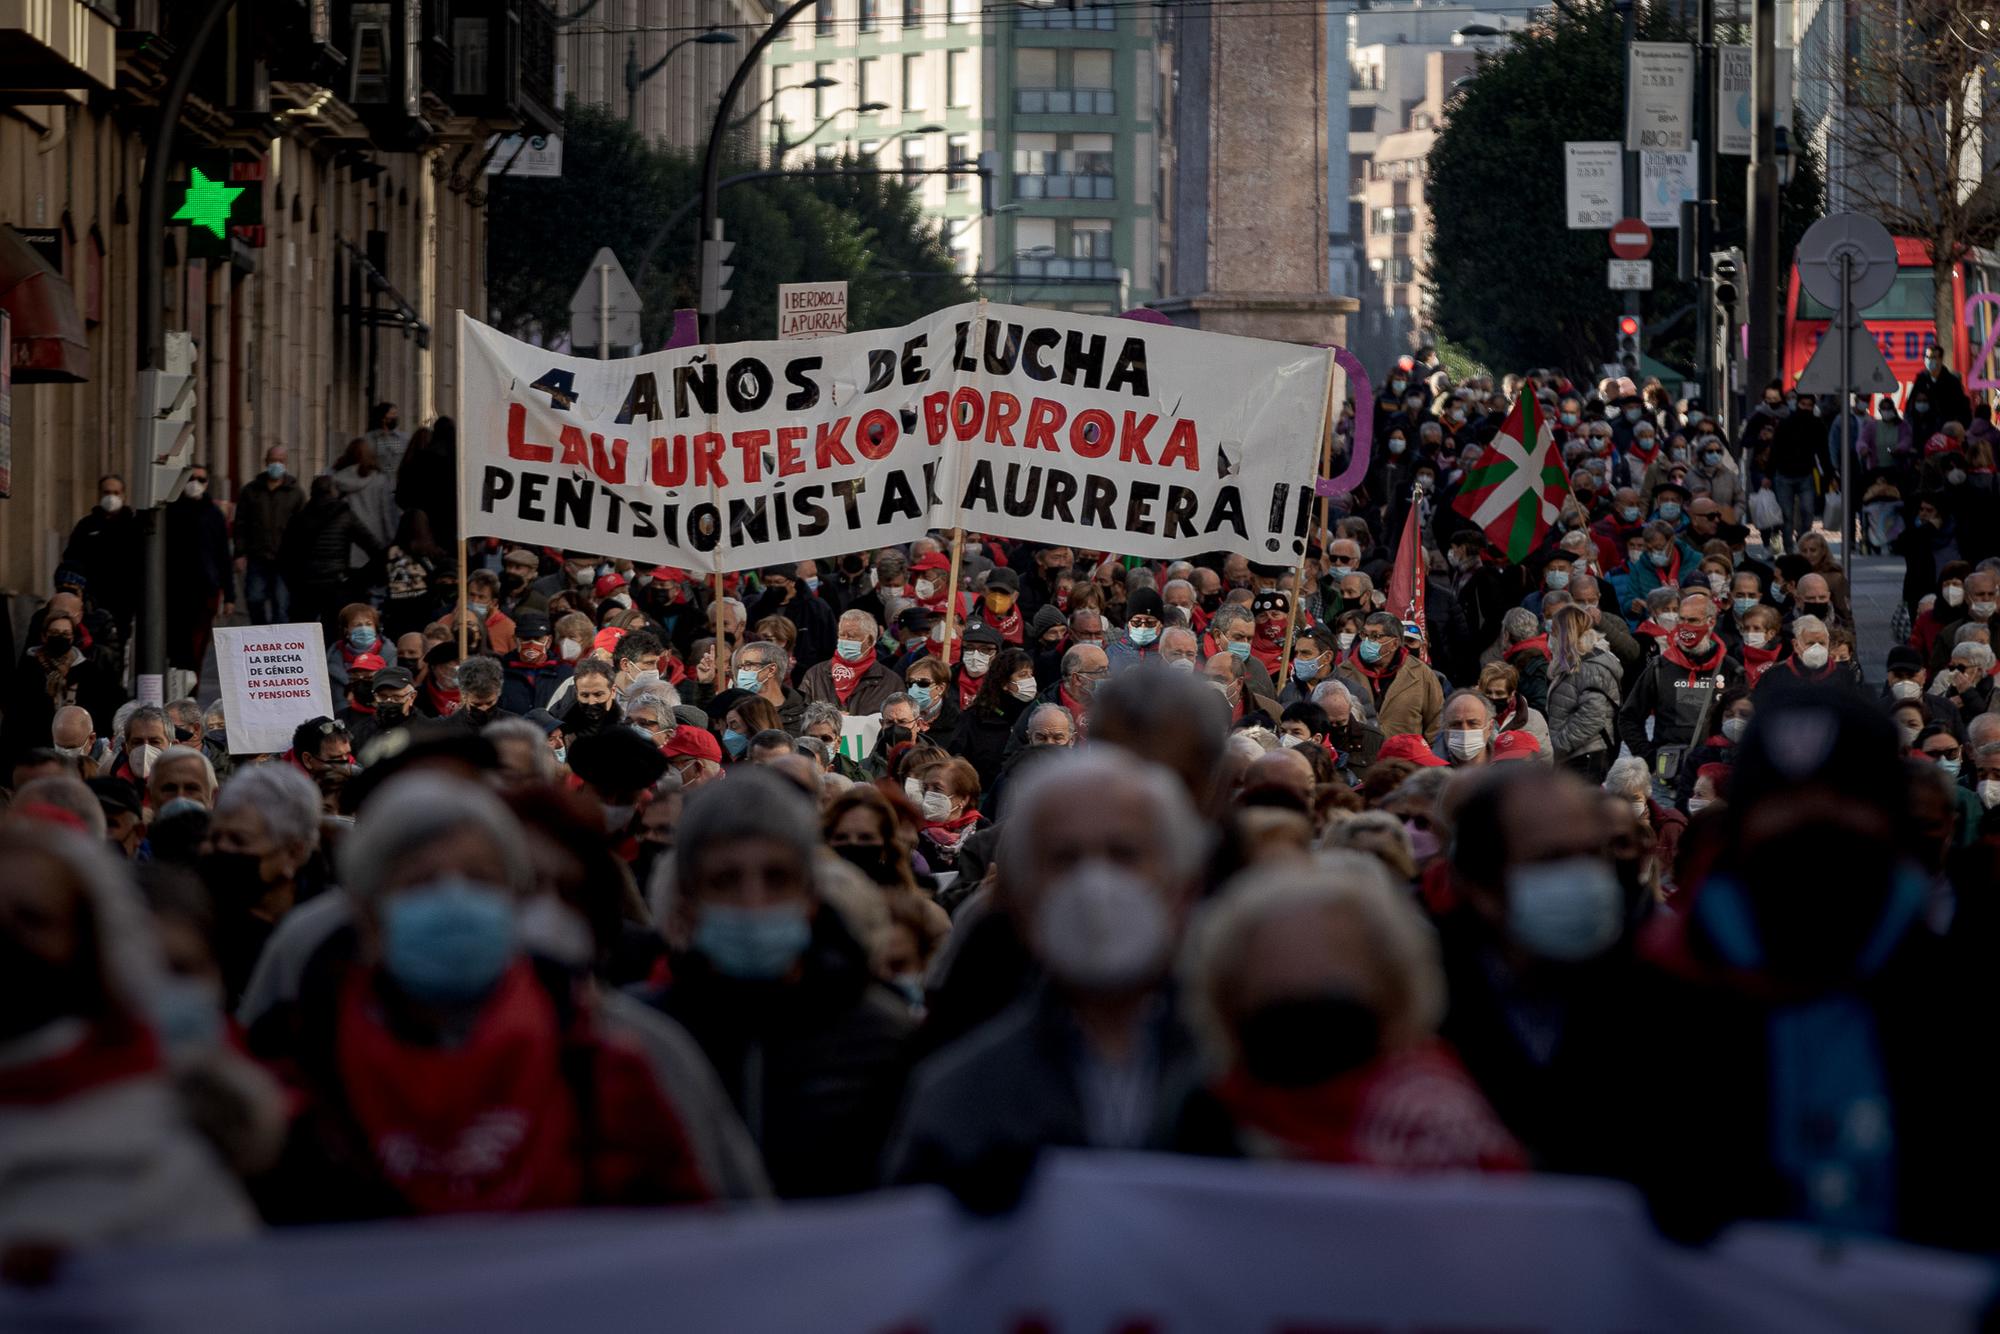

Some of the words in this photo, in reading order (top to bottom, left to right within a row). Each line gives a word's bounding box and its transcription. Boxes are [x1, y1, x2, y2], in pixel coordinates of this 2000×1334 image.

[785, 290, 845, 309] IBERDROLA
[783, 312, 847, 334] LAPURRAK
[530, 368, 579, 411] 4
[614, 354, 823, 424] AÑOS
[864, 333, 931, 394] DE
[953, 318, 1150, 397] LUCHA
[508, 402, 628, 484] LAU
[651, 408, 899, 488] URTEKO
[923, 386, 1200, 471] BORROKA
[243, 644, 282, 653] ACABAR
[284, 642, 305, 651] CON
[249, 656, 261, 664] LA
[263, 654, 302, 663] BRECHA
[250, 668, 263, 676] DE
[265, 665, 304, 675] GÉNERO
[248, 680, 260, 688] EN
[262, 678, 310, 687] SALARIOS
[258, 689, 311, 699] PENSIONES
